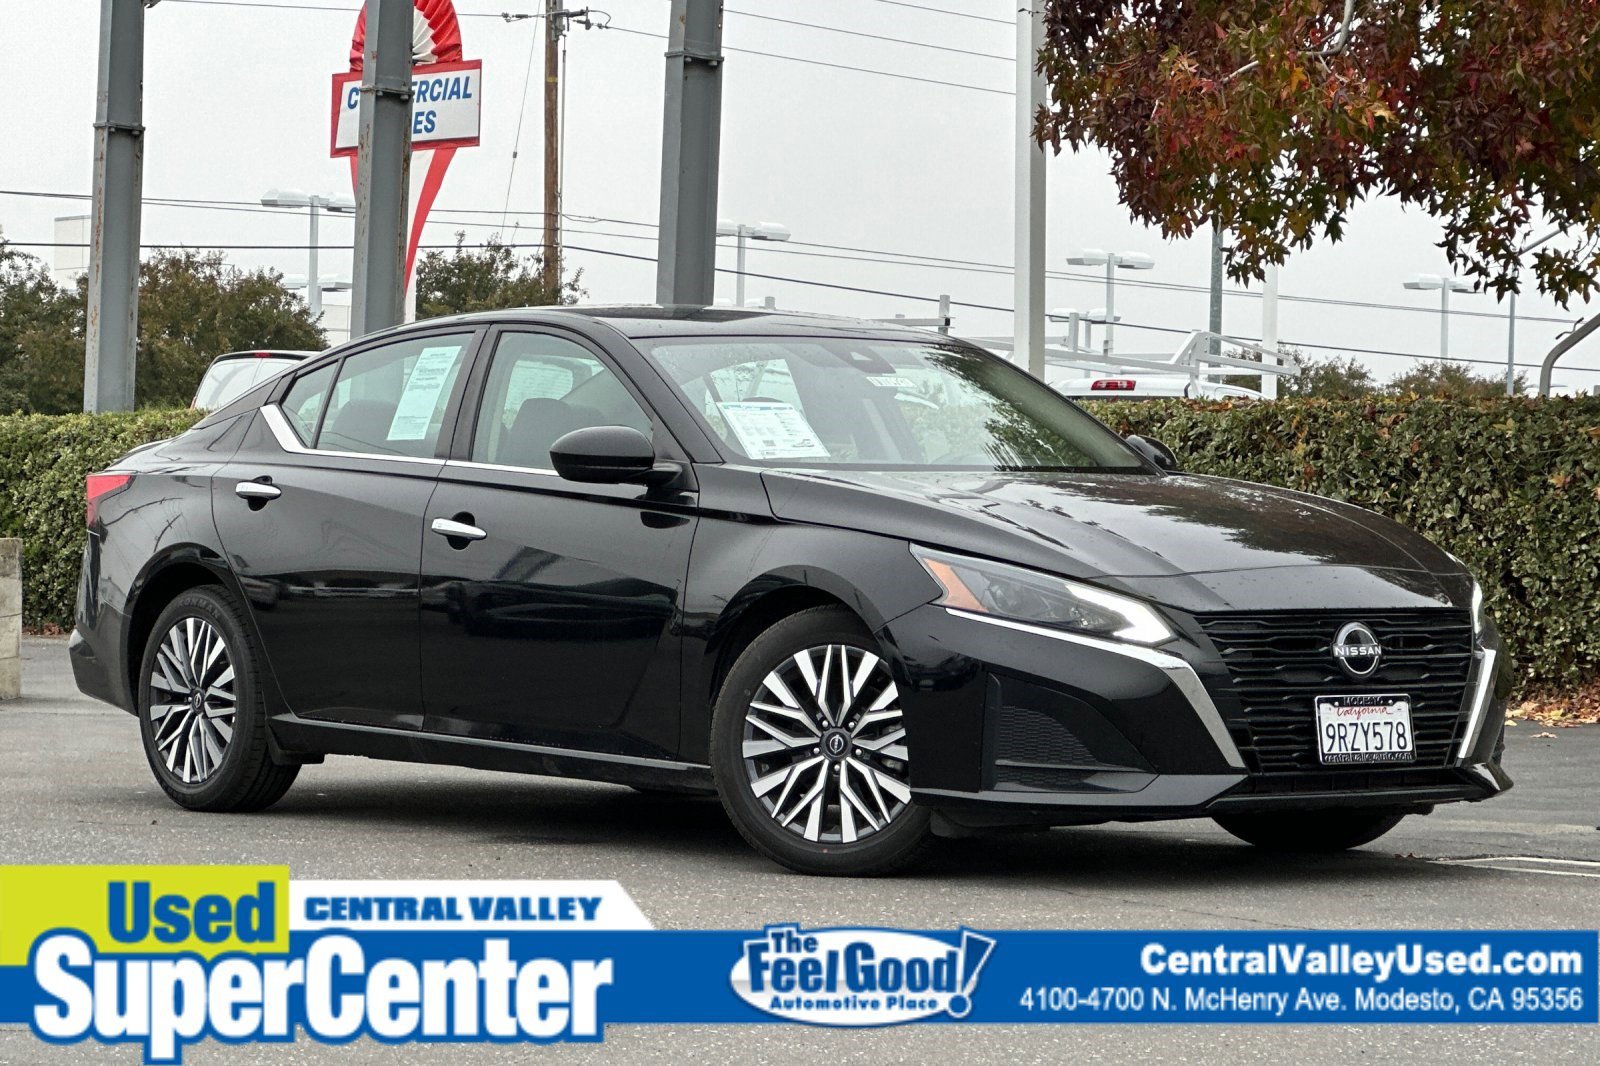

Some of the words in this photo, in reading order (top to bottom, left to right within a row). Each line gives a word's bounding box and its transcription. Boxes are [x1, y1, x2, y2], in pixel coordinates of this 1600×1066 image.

[347, 76, 473, 110] CRCIAL
[1335, 645, 1382, 656] NISSAN
[1336, 705, 1394, 721] California
[1325, 721, 1408, 753] 9RZY578
